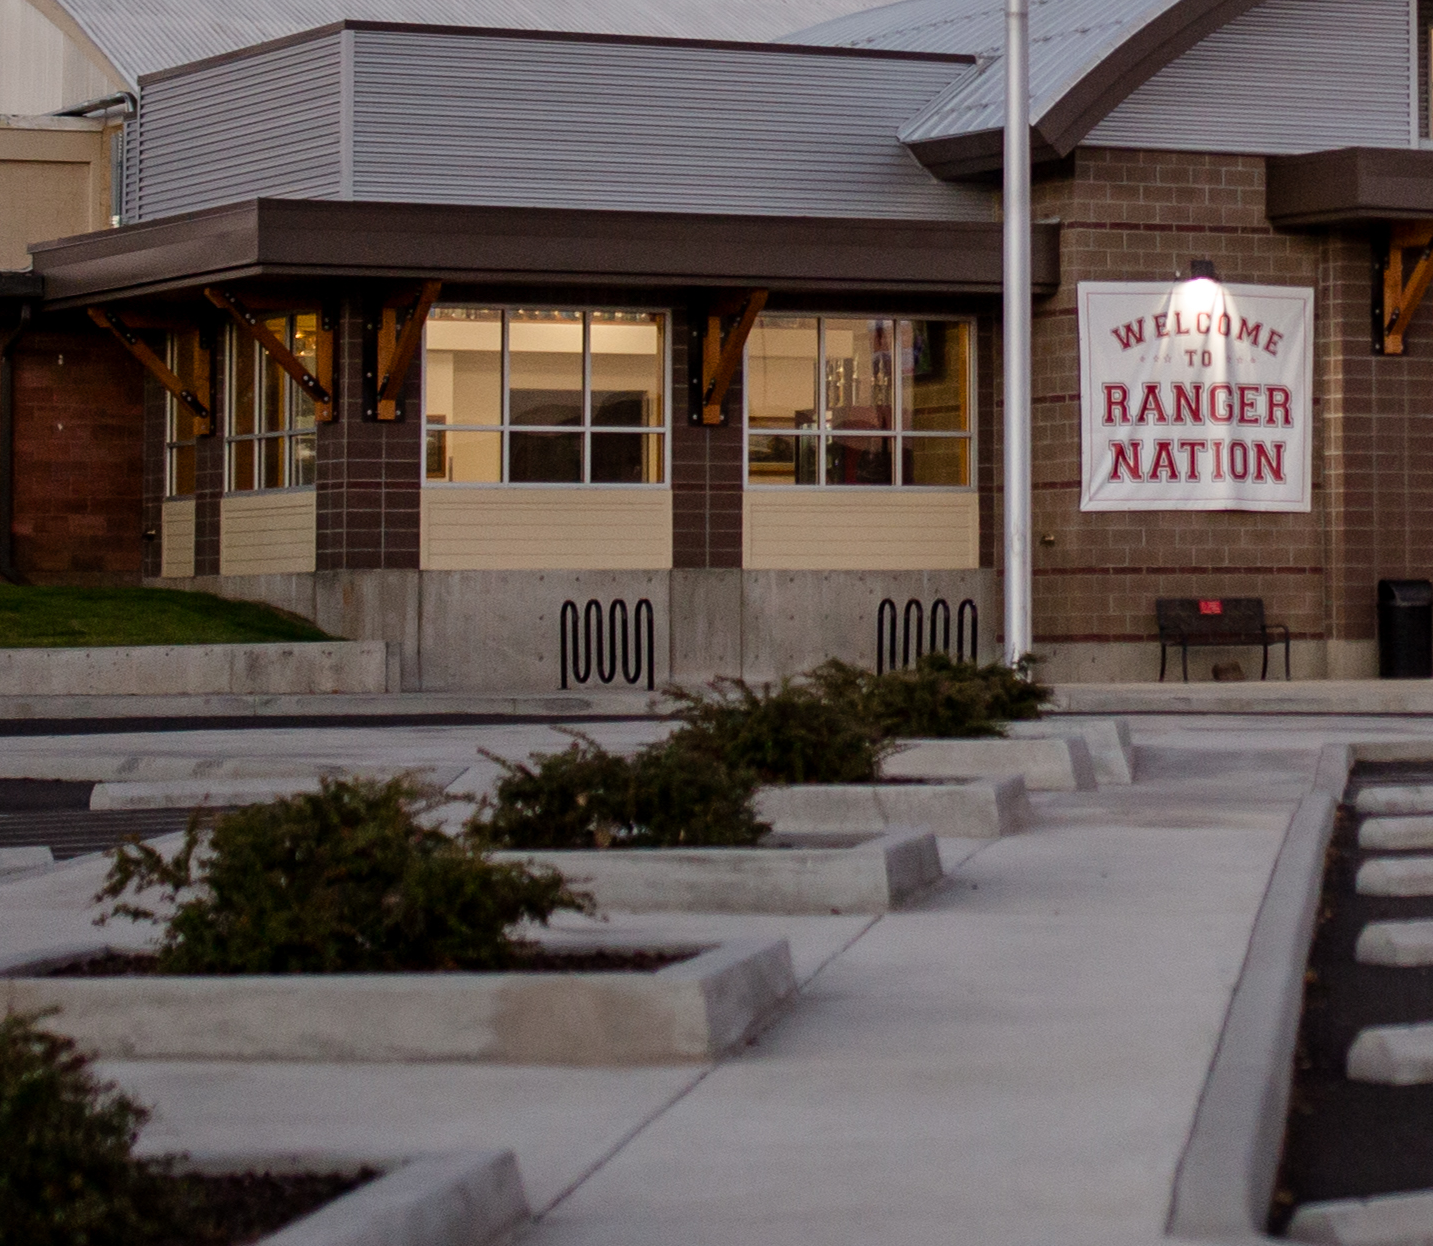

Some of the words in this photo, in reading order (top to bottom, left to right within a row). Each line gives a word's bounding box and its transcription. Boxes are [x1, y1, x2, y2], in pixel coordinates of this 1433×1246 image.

[1110, 310, 1285, 357] WELCOME
[1183, 349, 1213, 368] TO
[1101, 381, 1295, 429] RANGER
[1107, 438, 1287, 485] NATION
